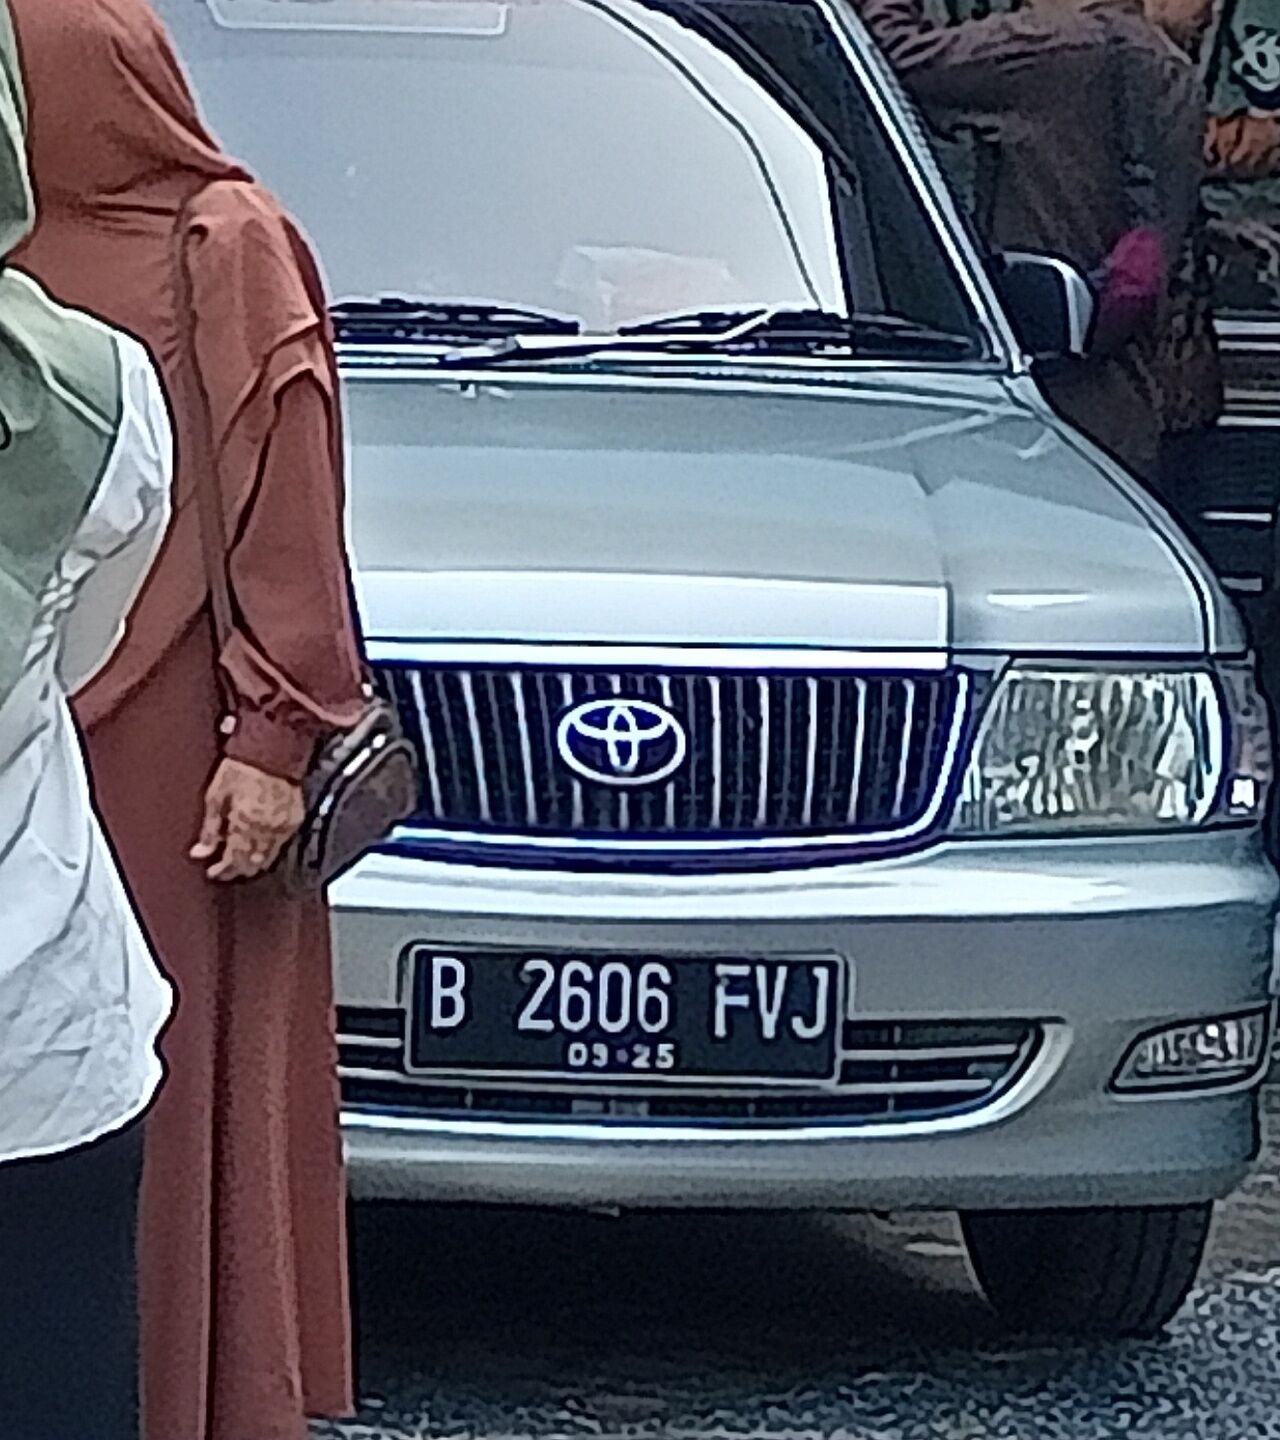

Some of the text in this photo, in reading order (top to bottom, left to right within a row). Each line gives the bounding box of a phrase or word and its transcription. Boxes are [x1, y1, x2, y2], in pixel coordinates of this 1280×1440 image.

[430, 957, 830, 1038] B 2606 FVJ
